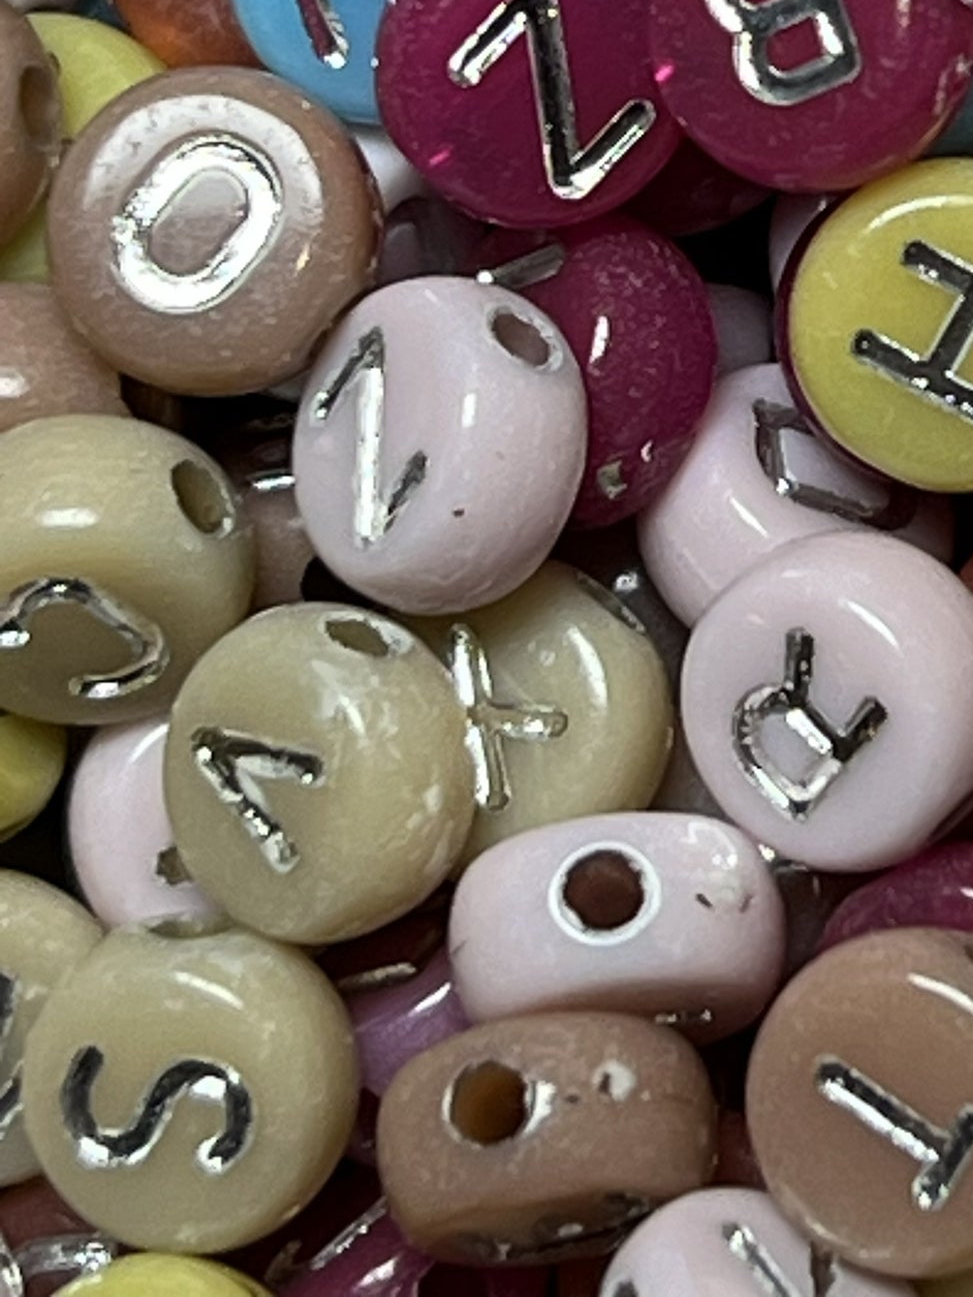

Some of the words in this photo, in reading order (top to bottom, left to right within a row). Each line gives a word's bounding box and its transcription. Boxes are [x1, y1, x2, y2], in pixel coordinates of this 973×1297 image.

[110, 130, 282, 314] O
[730, 626, 888, 821] R
[58, 1044, 254, 1176] S
